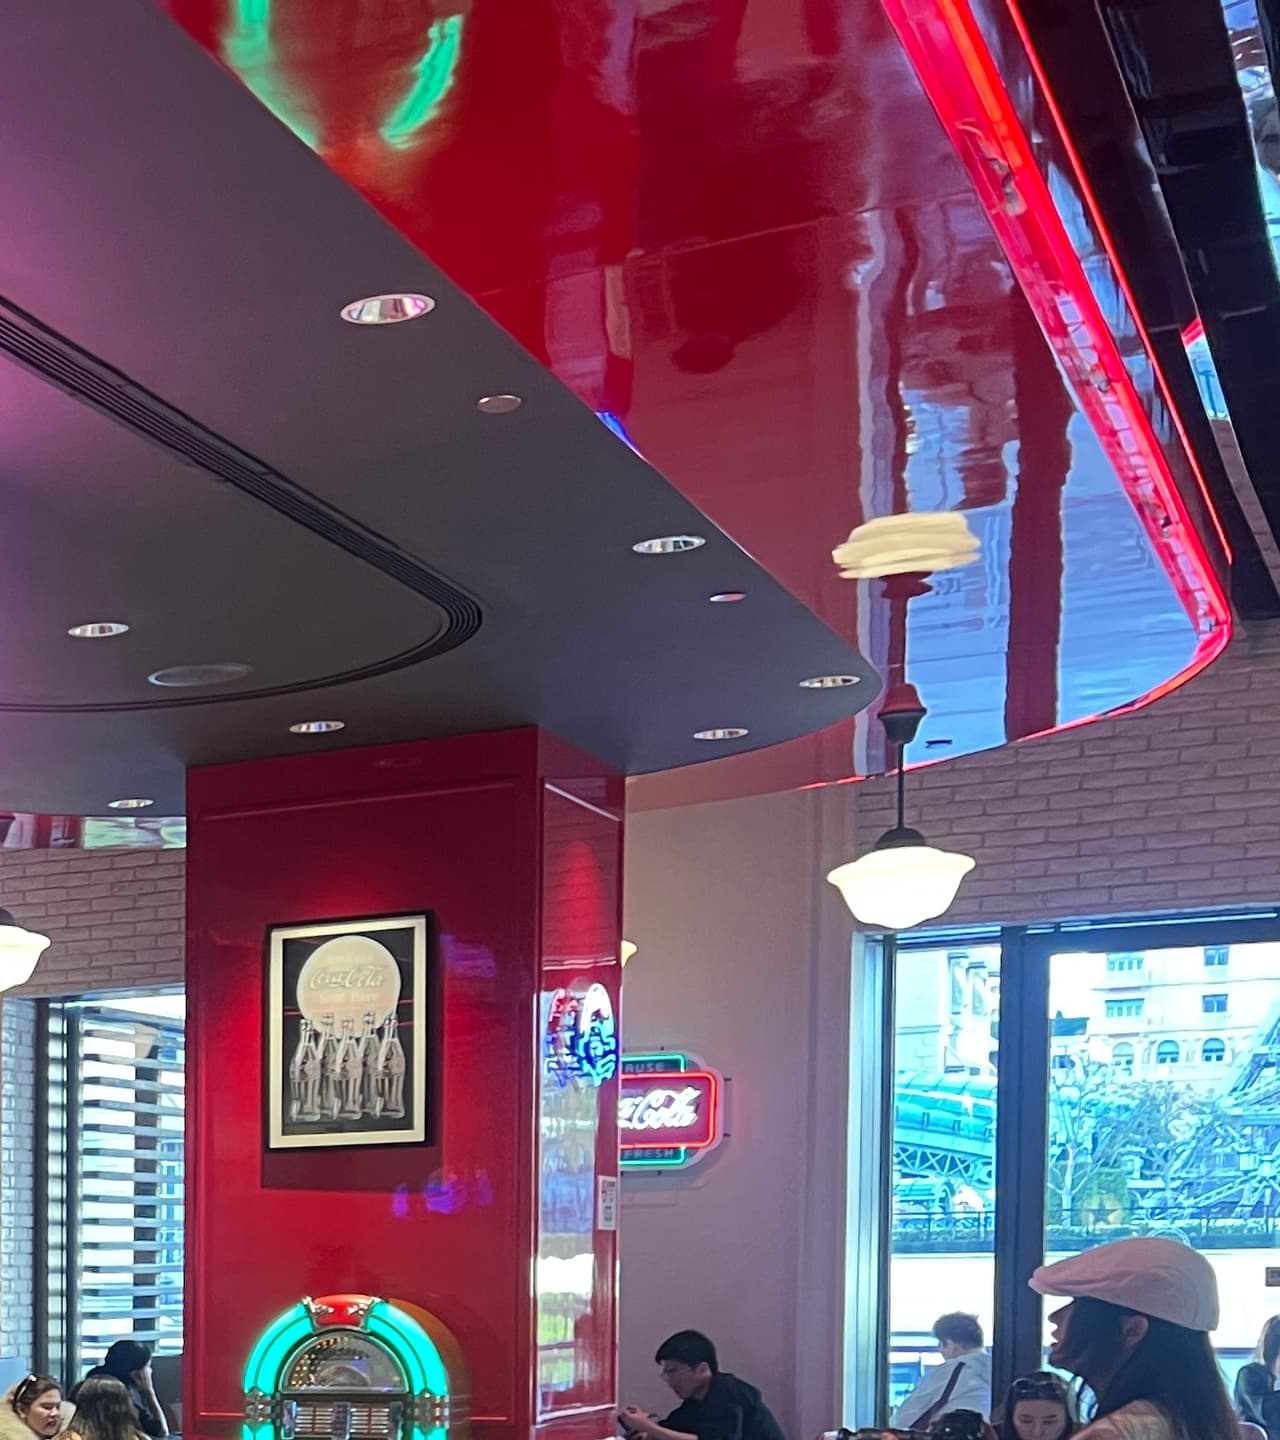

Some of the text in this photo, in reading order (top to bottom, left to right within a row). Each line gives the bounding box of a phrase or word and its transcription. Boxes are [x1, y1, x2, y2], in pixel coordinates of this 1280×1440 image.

[308, 963, 387, 992] Coca-Cola
[624, 1062, 665, 1073] AUSE
[623, 1148, 675, 1159] FRESH
